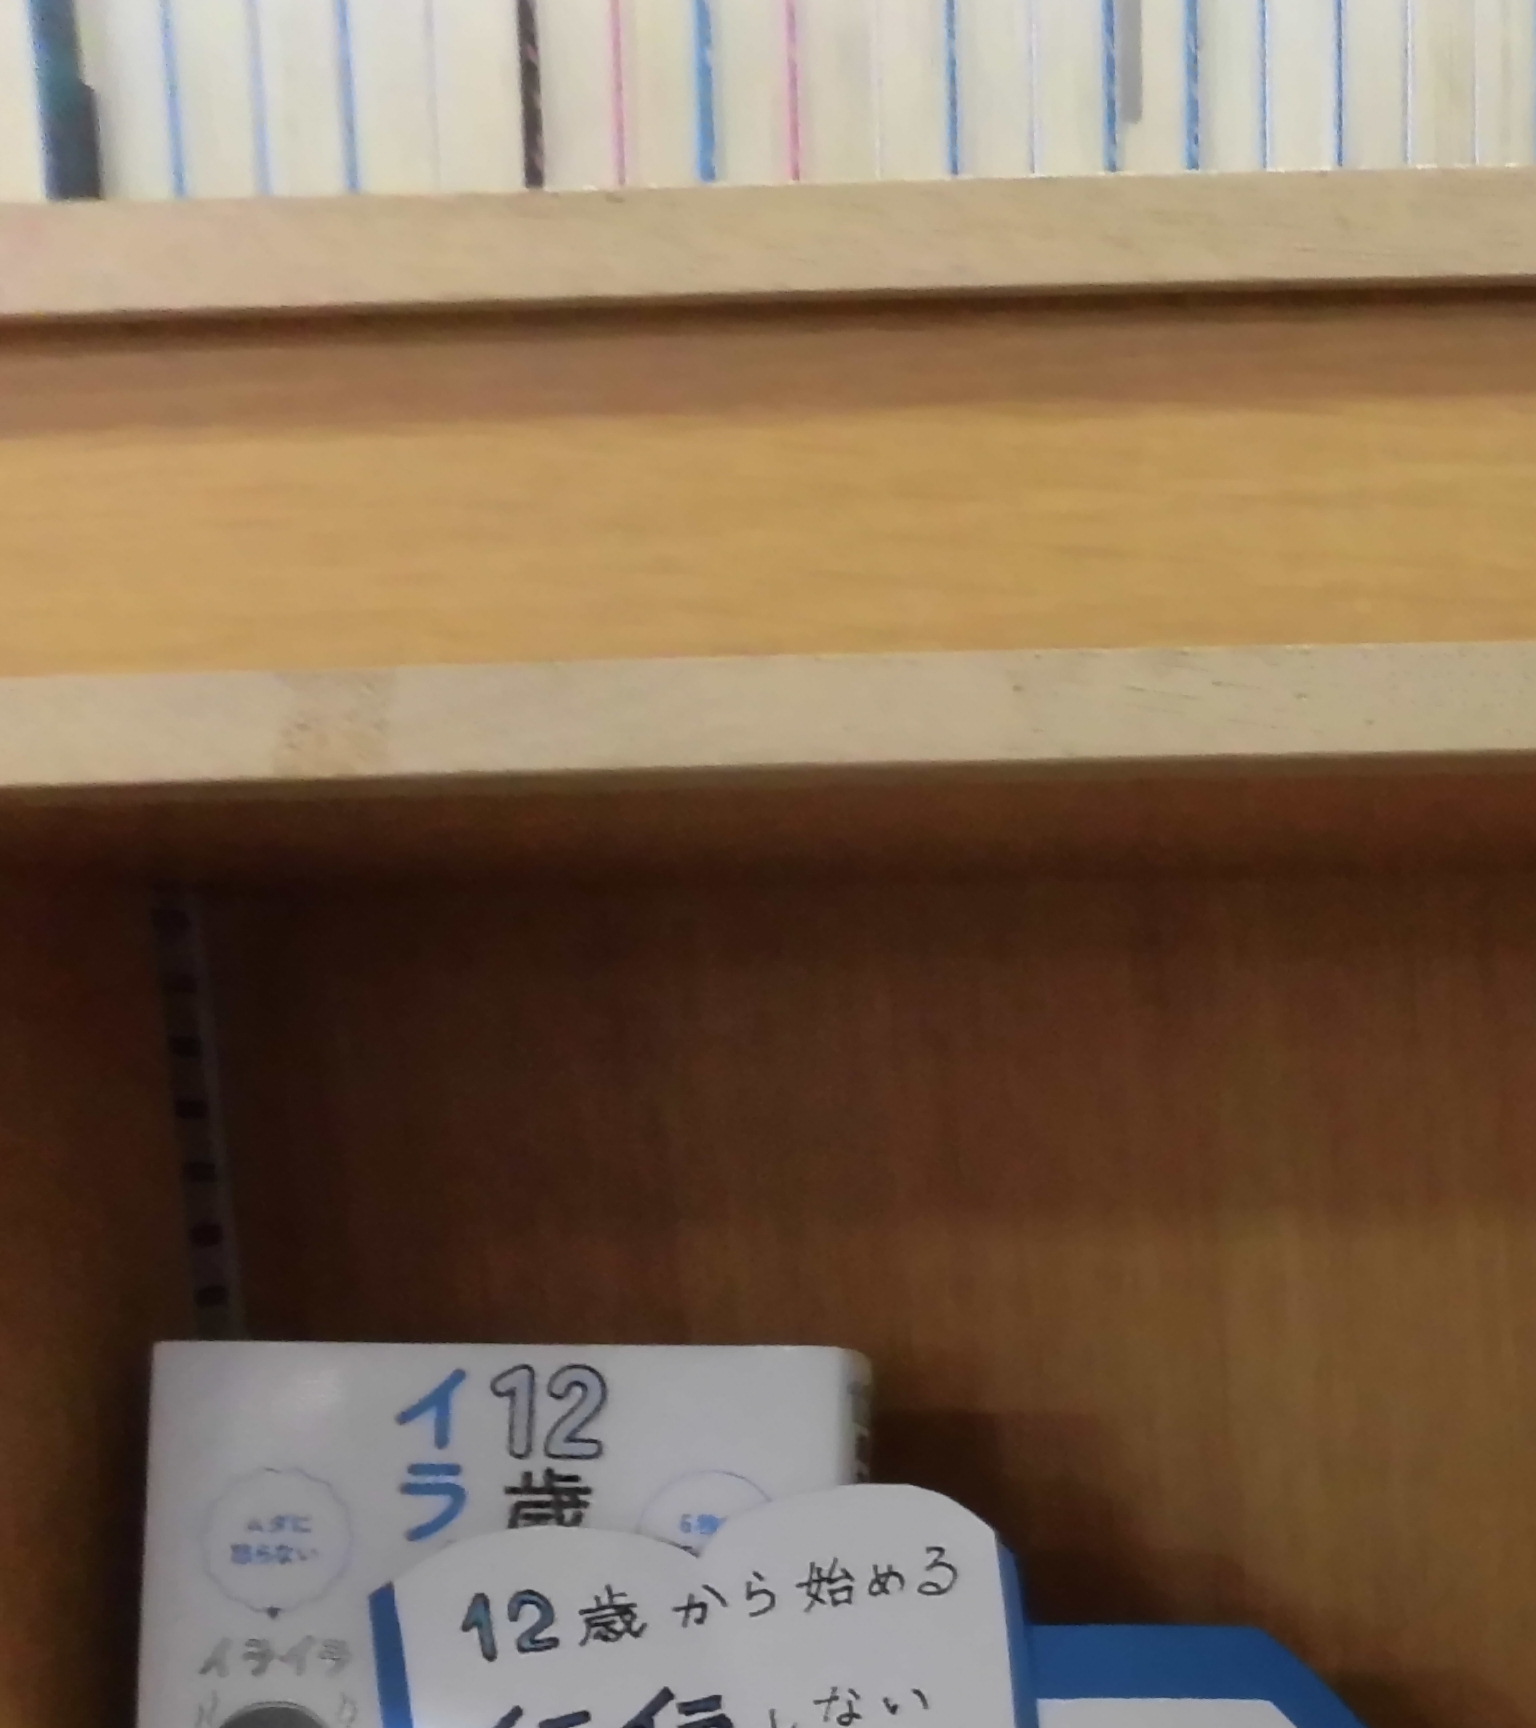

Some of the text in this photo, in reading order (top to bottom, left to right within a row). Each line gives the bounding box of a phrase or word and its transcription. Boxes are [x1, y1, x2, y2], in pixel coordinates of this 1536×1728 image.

[460, 1545, 960, 1663] 12歳から始める
